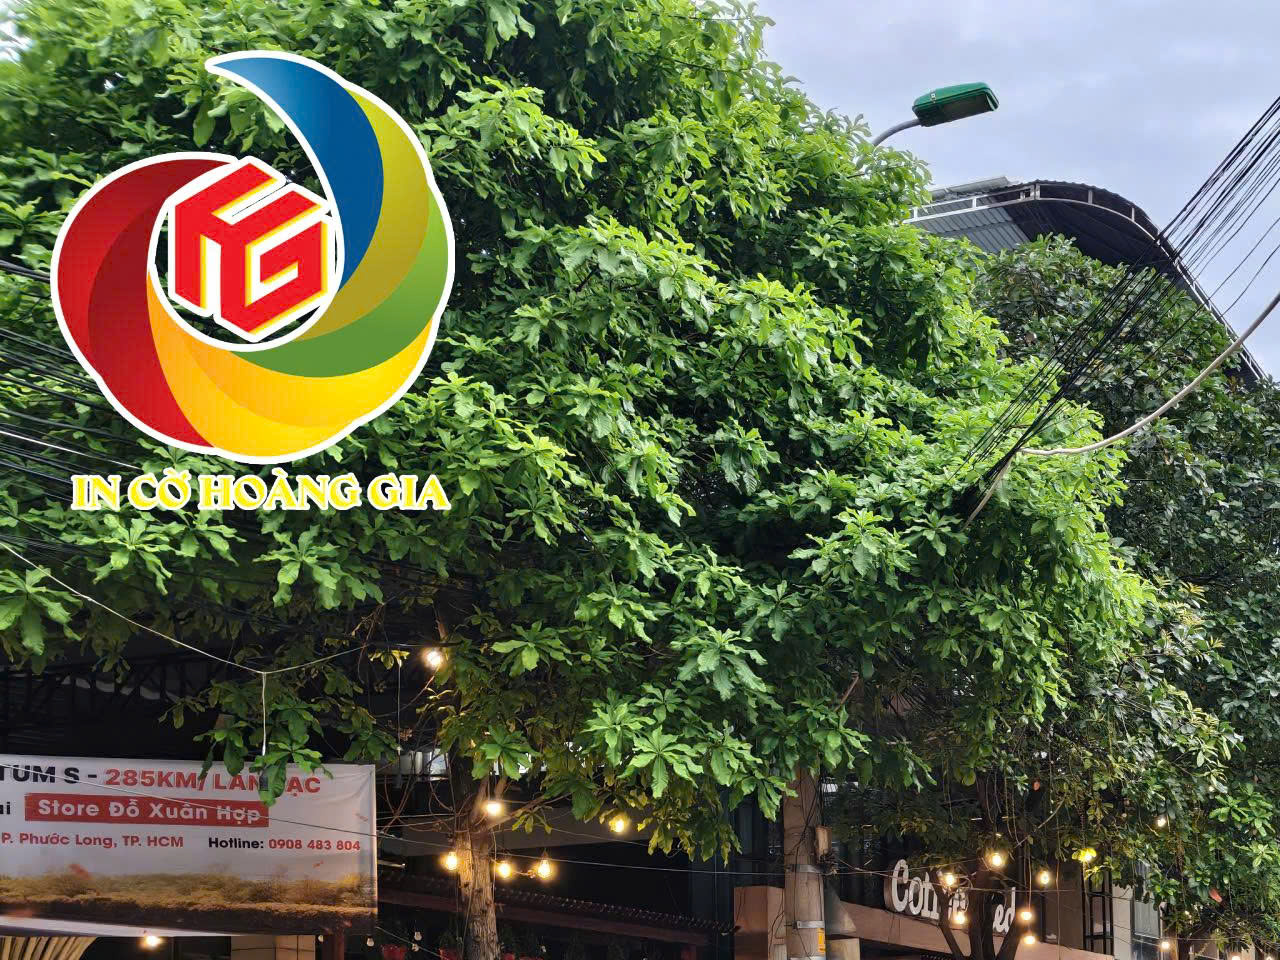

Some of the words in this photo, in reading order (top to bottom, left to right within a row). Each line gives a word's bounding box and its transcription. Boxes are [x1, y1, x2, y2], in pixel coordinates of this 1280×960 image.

[64, 767, 80, 784] S
[285, 776, 321, 797] ẠC
[38, 799, 100, 817] Store
[109, 799, 140, 818] Đỗ
[149, 802, 208, 820] Xuân
[216, 805, 261, 824] Hợp
[1, 832, 13, 844] P.
[19, 832, 70, 846] Phước
[75, 834, 118, 849] Long,
[122, 835, 142, 847] TP.
[147, 836, 184, 847] HCM
[208, 836, 264, 849] Hotline:
[268, 838, 303, 850] 0908
[307, 838, 332, 851] 483
[336, 840, 361, 851] 804
